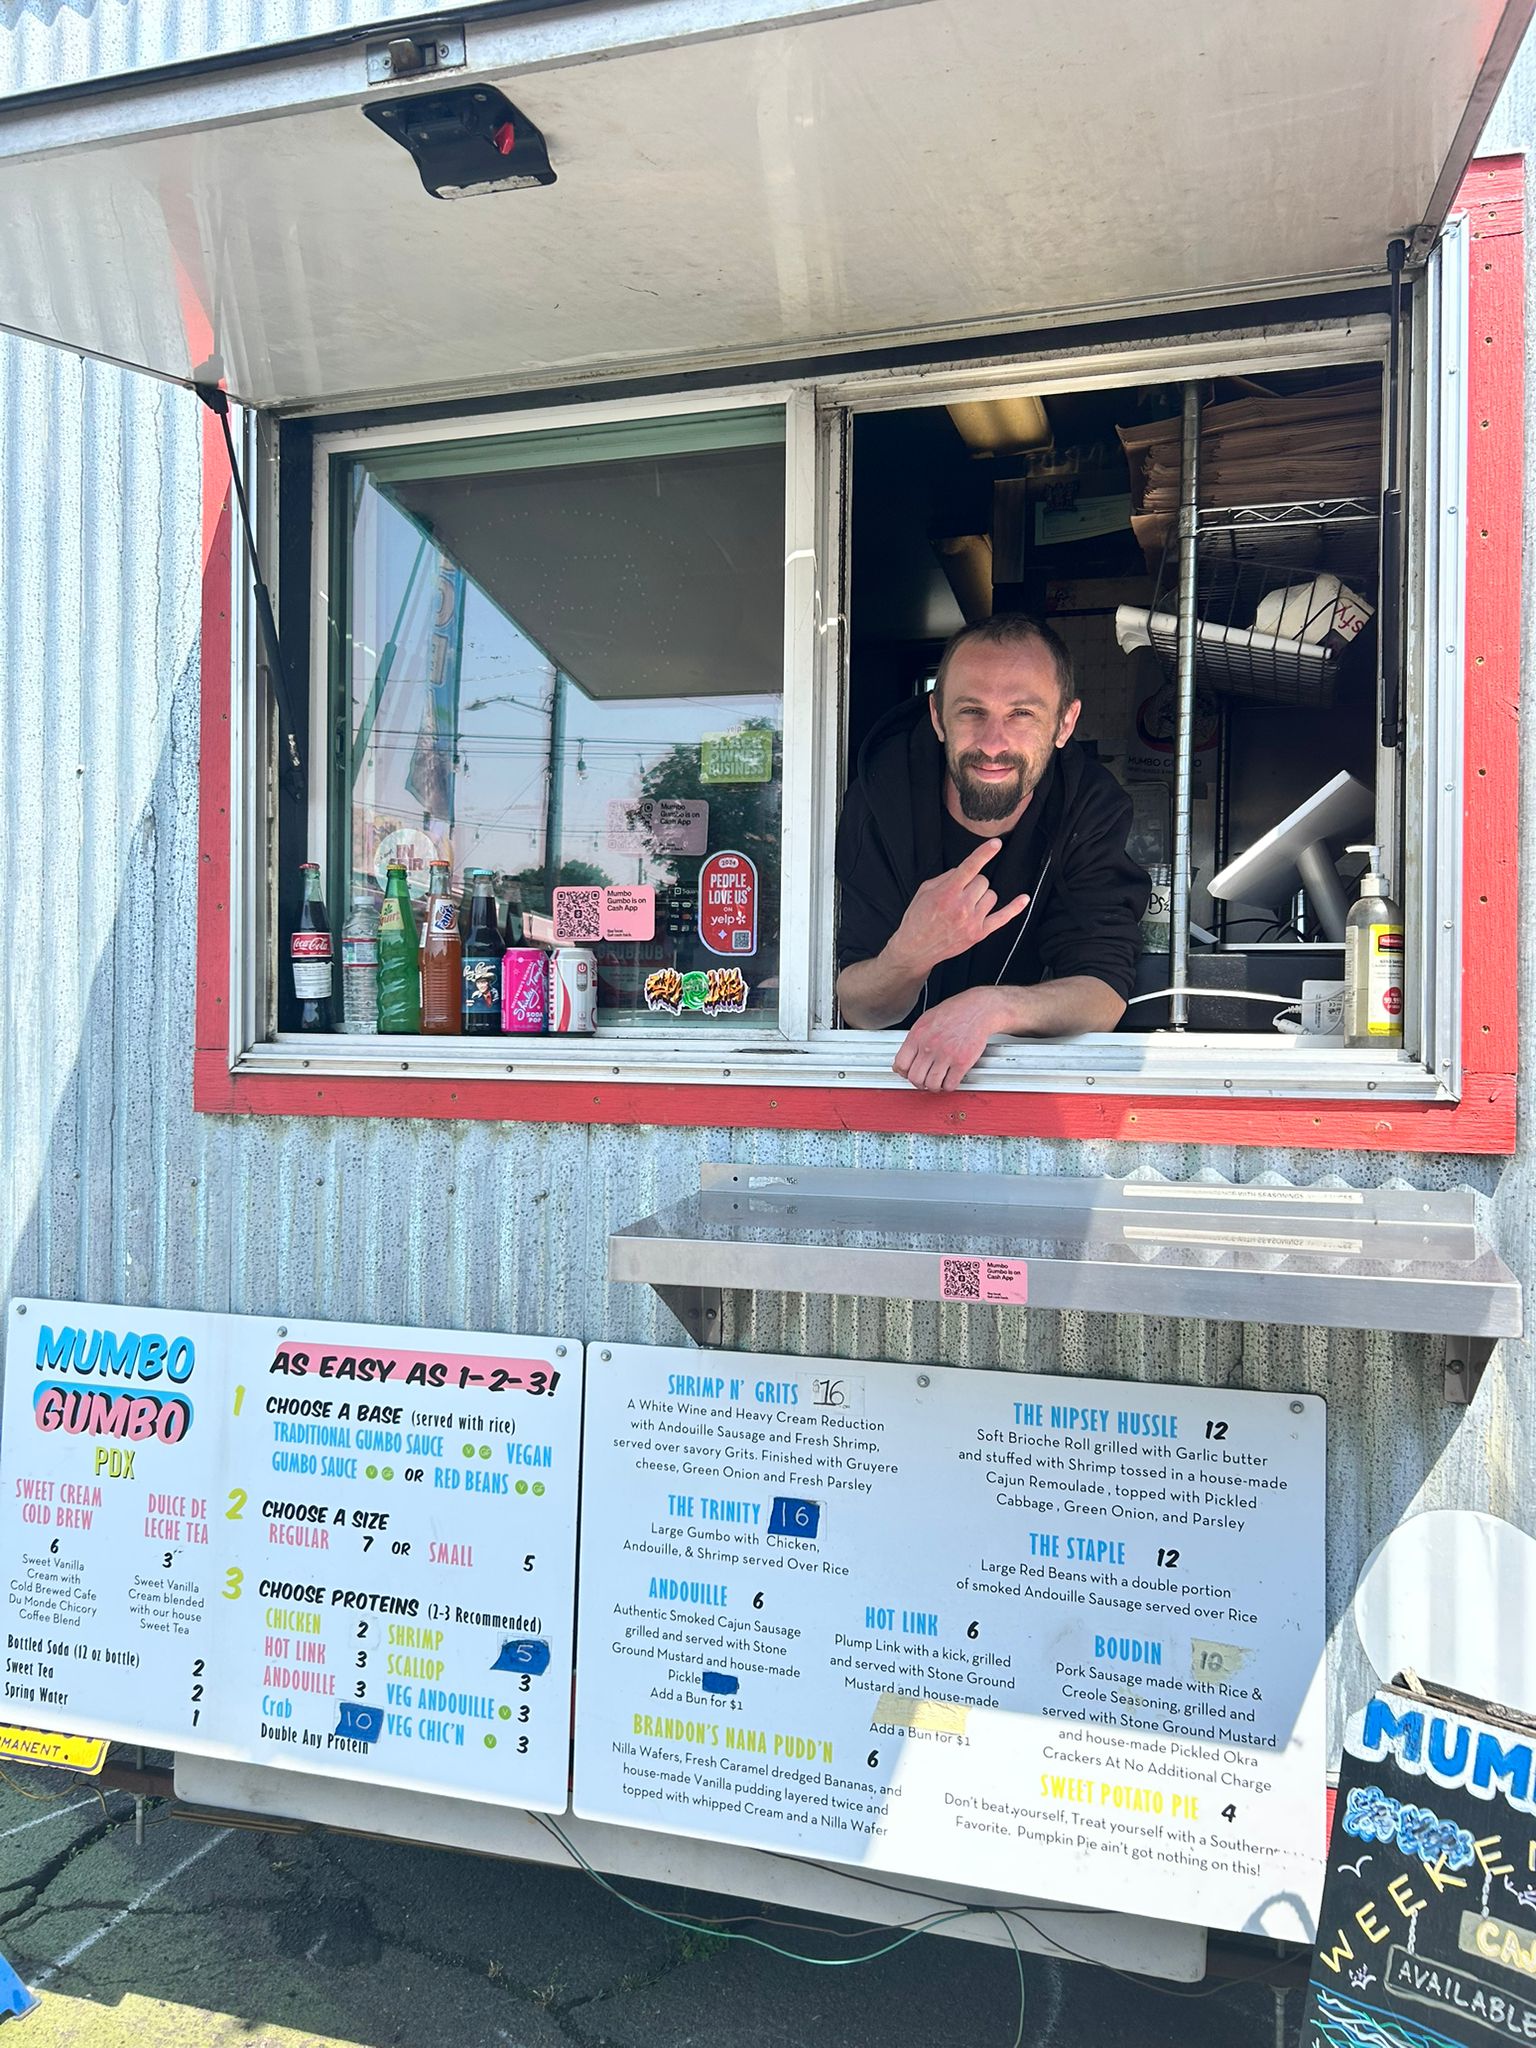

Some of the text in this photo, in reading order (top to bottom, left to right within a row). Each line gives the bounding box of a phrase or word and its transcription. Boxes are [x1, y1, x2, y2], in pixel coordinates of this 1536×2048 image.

[709, 762, 764, 776] BUSINESS
[711, 874, 747, 888] PEOPLE
[709, 890, 747, 905] LOVE US
[435, 904, 456, 930] Fanta
[711, 914, 735, 925] yelp
[36, 1325, 195, 1383] MUMBO
[269, 1351, 561, 1397] AS EASY AS 1-2-3!
[668, 1374, 799, 1405] SHRIMP N' GRITS
[35, 1387, 190, 1445] GUMBO
[233, 1385, 246, 1417] 1
[266, 1396, 516, 1436] CHOOSE A BASE (served with rice)
[1014, 1402, 1229, 1441] THE NIPSEY HUSSLE 12
[273, 1421, 552, 1468] TRADITIONAL GUMBO SAUCE VEGAN
[977, 1429, 1268, 1467] Soft Brioche Roll grilled with Garlic butter
[94, 1447, 135, 1479] PDX
[272, 1451, 509, 1495] GUMBO SAUCE OR RED BEANS
[15, 1479, 102, 1507] SWEET CREAM
[149, 1493, 207, 1520] DULCE DE
[225, 1488, 247, 1520] 2
[22, 1503, 93, 1530] COLD BREW
[262, 1500, 390, 1531] CHOOSE A SIZE
[668, 1495, 761, 1525] THE TRINITY
[50, 1539, 59, 1553] 6
[144, 1518, 209, 1545] LECHE TEA
[269, 1522, 535, 1572] REGULAR 7 OR SMALL 5
[22, 1554, 84, 1572] Sweet Vanilla
[162, 1552, 173, 1568] 3
[1029, 1532, 1180, 1568] THE STAPLE 12
[222, 1567, 244, 1600] 3
[649, 1577, 764, 1609] ANDOUILLE 6
[259, 1579, 542, 1635] CHOOSE PROTEINS (2-3 Recommended)
[266, 1607, 444, 1651] CHICKEN 2 SHRIMP
[865, 1607, 979, 1640] HOT LINK 6
[8, 1635, 140, 1668] Bottled Soda (12 oz bottle)
[265, 1636, 532, 1692] HOT LINK 3 SCALLOP 3
[516, 1644, 533, 1663] 5
[1094, 1635, 1163, 1666] BOUDIN
[6, 1658, 54, 1679] Sweet Tea
[192, 1659, 205, 1677] 2
[5, 1682, 68, 1706] Spring Water
[190, 1684, 203, 1702] 2
[263, 1665, 530, 1723] ANDOUILLE 3 VEG ANDOUILLE 3
[192, 1710, 200, 1726] 1
[262, 1695, 529, 1754] Crab VEG CHIC'N 3
[0, 1736, 61, 1757] MANENT
[261, 1723, 369, 1755] Double Any Protein
[633, 1713, 879, 1768] BRANDON'S NANA PUDD'N 6
[1363, 1698, 1536, 1801] MUM
[1040, 1774, 1236, 1823] SWEET POTATO PIE 4
